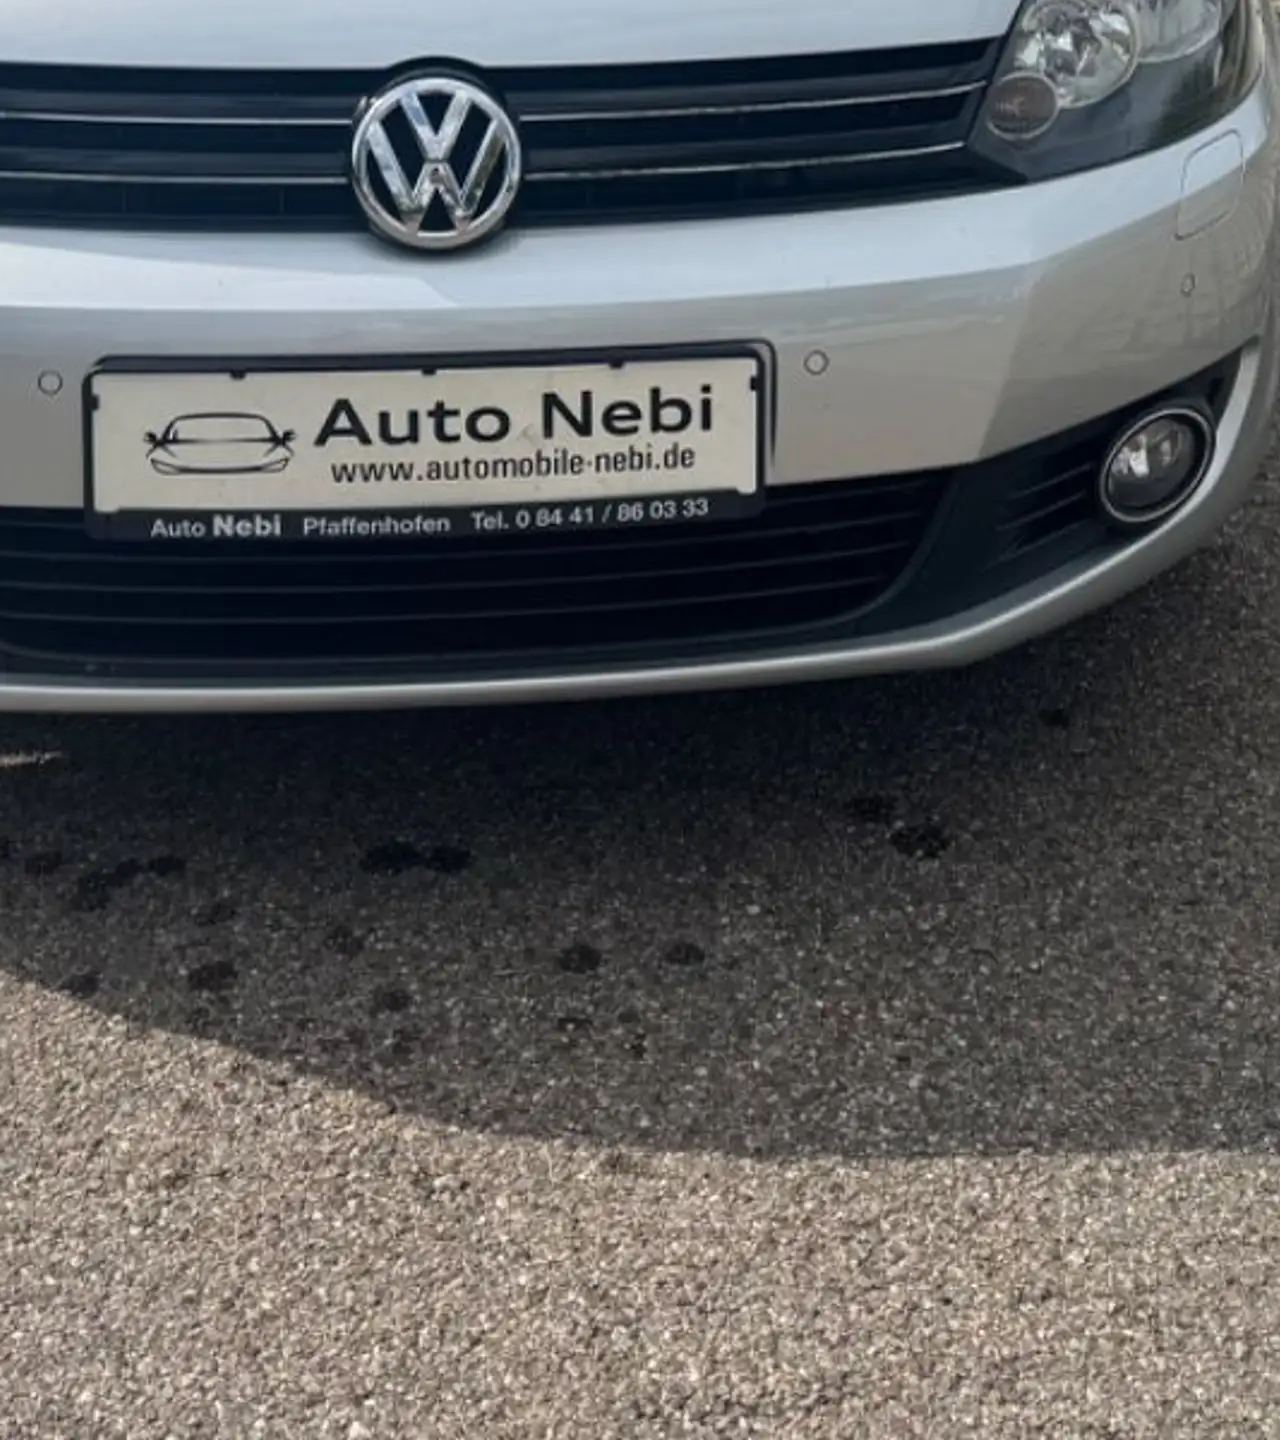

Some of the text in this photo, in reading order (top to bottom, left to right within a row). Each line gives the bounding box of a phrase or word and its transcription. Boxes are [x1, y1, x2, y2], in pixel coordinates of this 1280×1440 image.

[313, 383, 713, 447] Auto Nebi
[331, 442, 696, 484] www.automobile-nebi.de
[150, 517, 207, 539] Auto
[212, 513, 282, 538] Nebi
[303, 513, 452, 537] Pfaffenhofen
[471, 510, 510, 532] Tel.
[535, 507, 563, 528] 84
[568, 505, 594, 525] 41
[617, 502, 644, 522] 86
[649, 500, 677, 520] 03
[681, 497, 710, 518] 33
